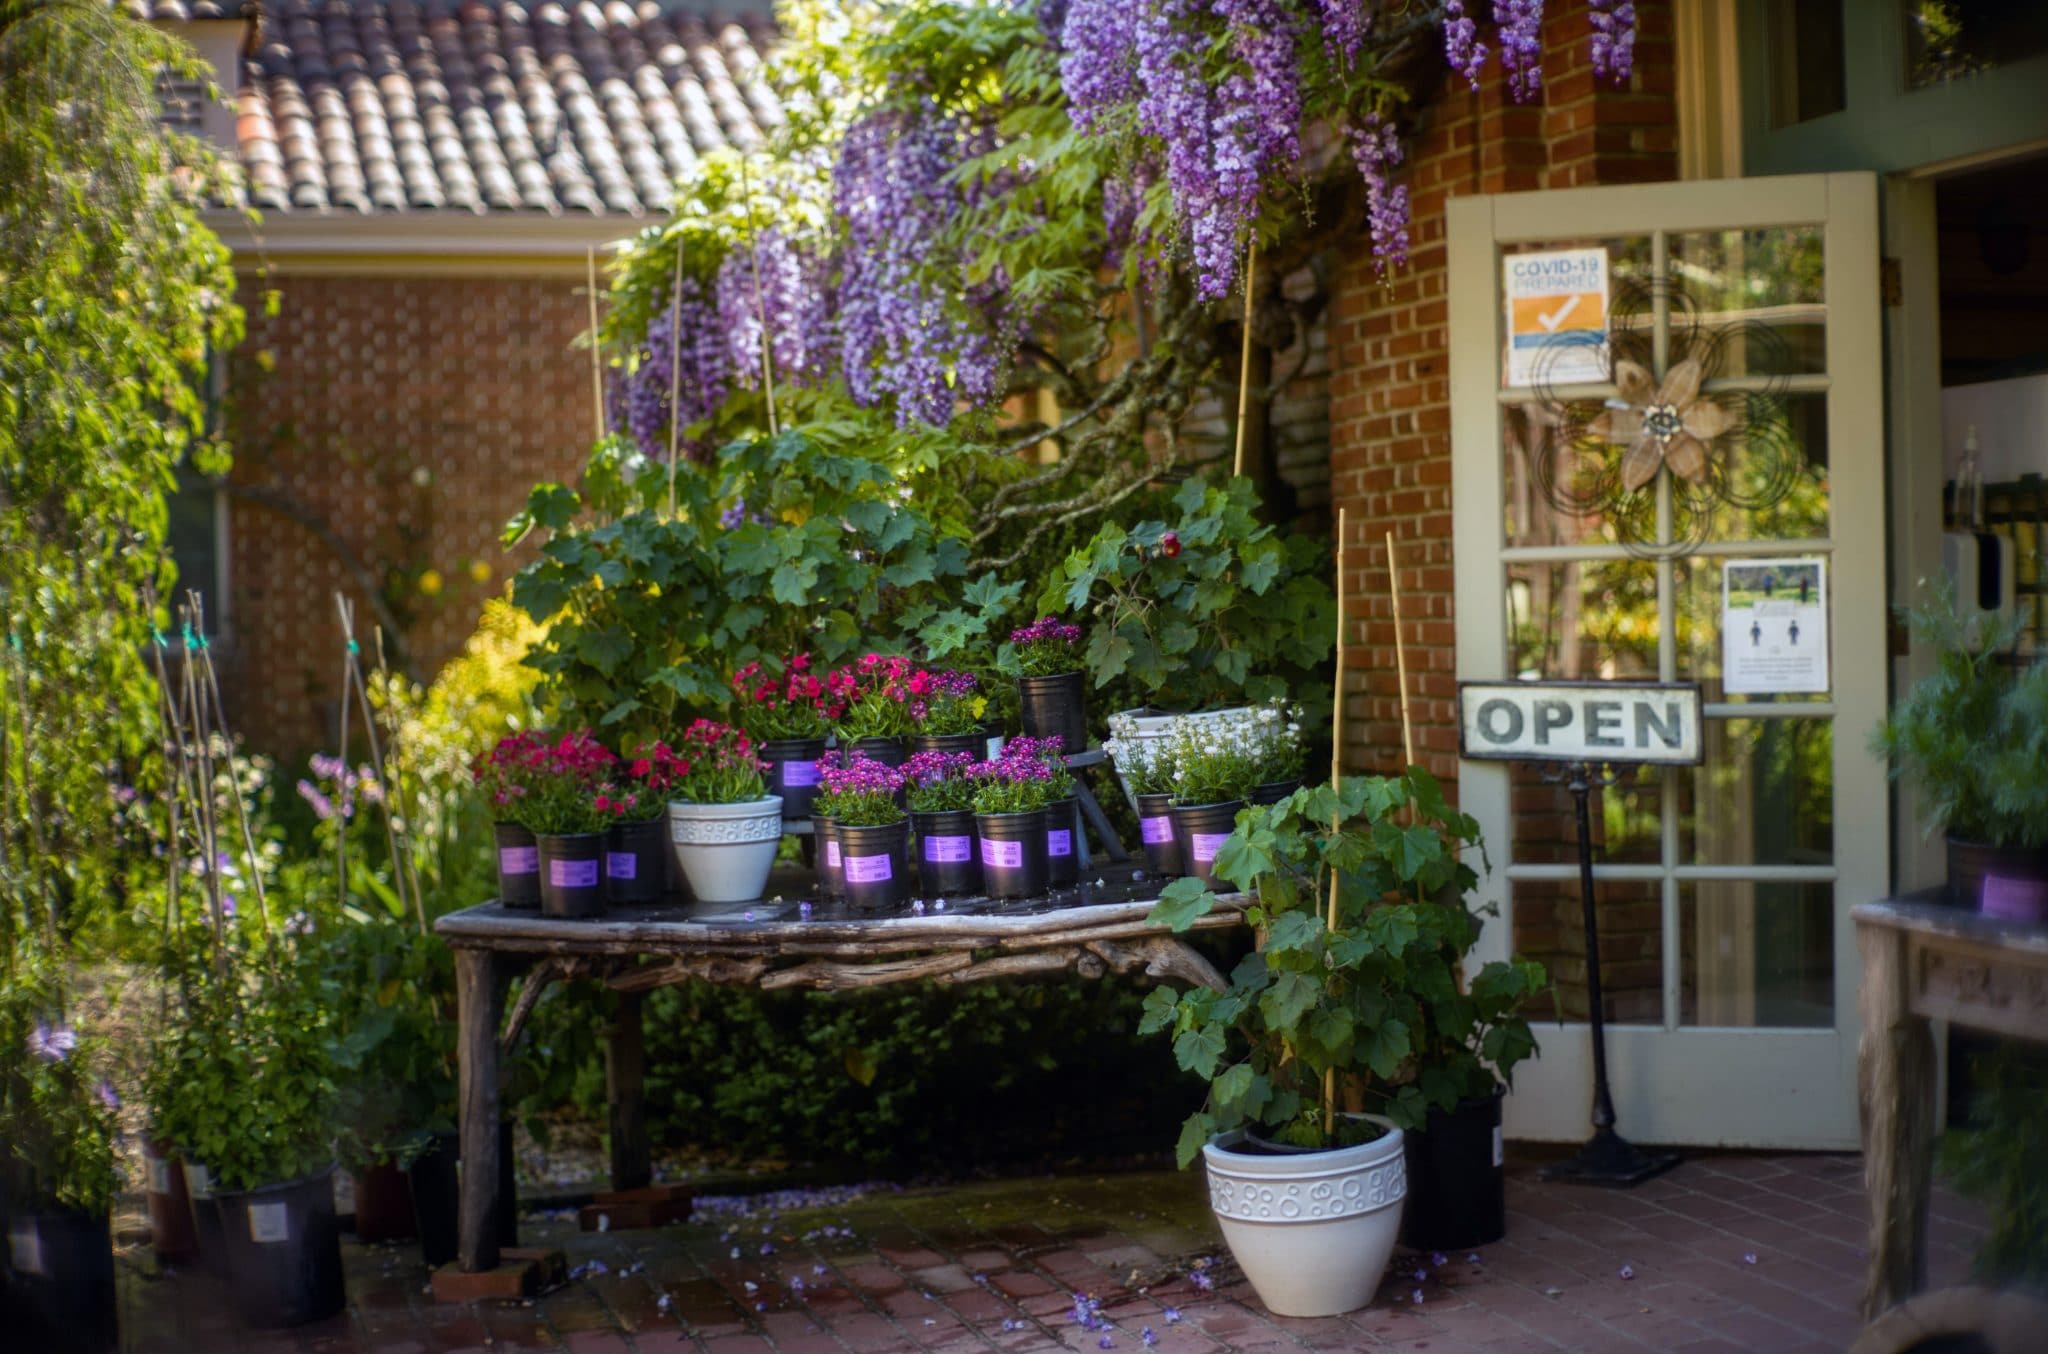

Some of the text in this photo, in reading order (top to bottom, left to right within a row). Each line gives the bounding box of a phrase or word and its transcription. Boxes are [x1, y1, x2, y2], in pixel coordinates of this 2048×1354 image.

[1514, 257, 1598, 276] COVID-19
[1514, 272, 1599, 289] PREPARED
[1477, 698, 1682, 749] OPEN
